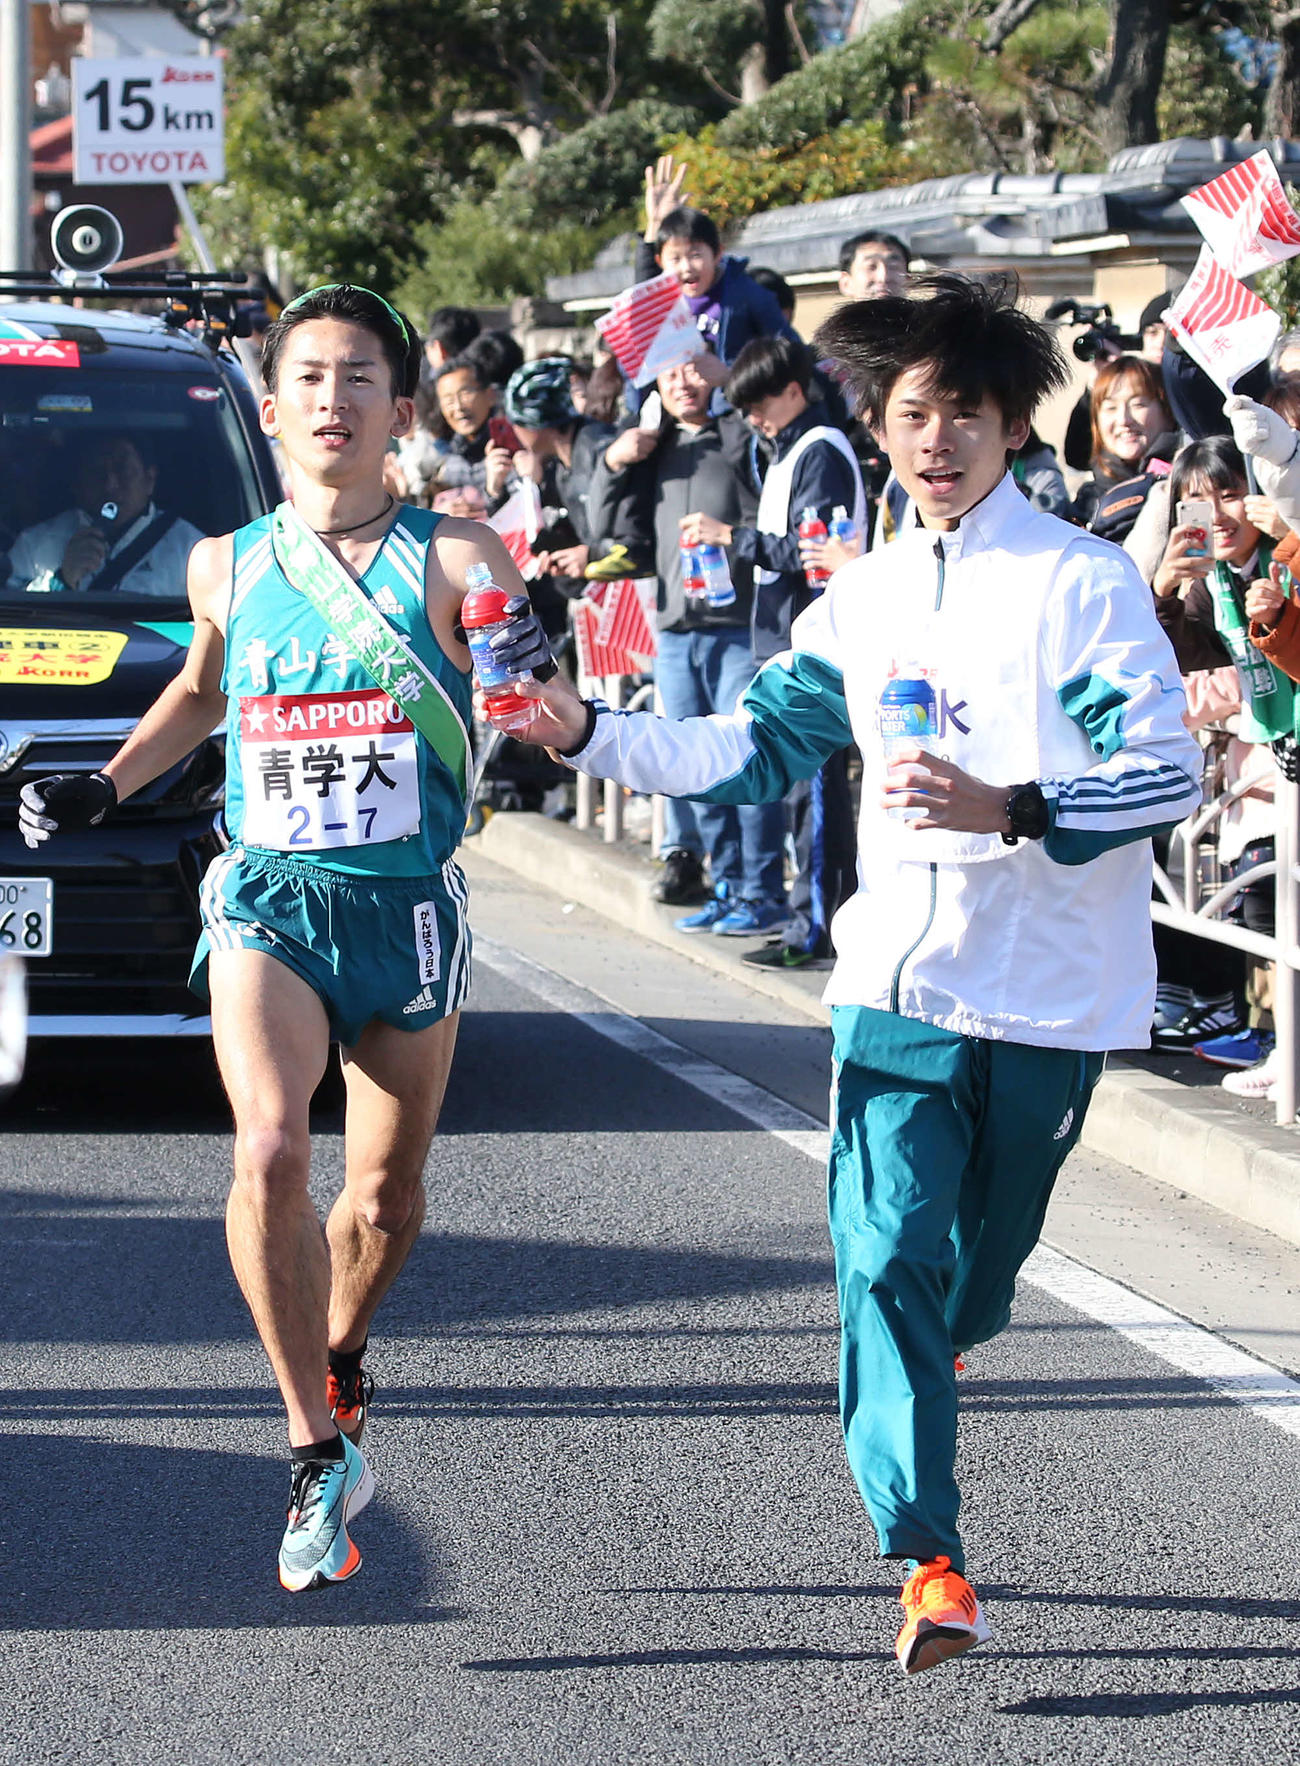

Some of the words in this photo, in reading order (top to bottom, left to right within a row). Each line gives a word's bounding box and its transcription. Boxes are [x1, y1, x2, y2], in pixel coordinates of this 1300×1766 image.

[84, 78, 155, 132] 15
[163, 103, 214, 130] km
[92, 151, 208, 173] TOYOTA
[289, 540, 427, 703] 山学院大学
[0, 653, 104, 664] 大学
[239, 631, 411, 688] 青山学
[272, 699, 407, 733] SAPPORO
[257, 740, 398, 801] 青学大
[420, 909, 435, 979] がんばろう日本
[403, 1000, 436, 1014] adidas
